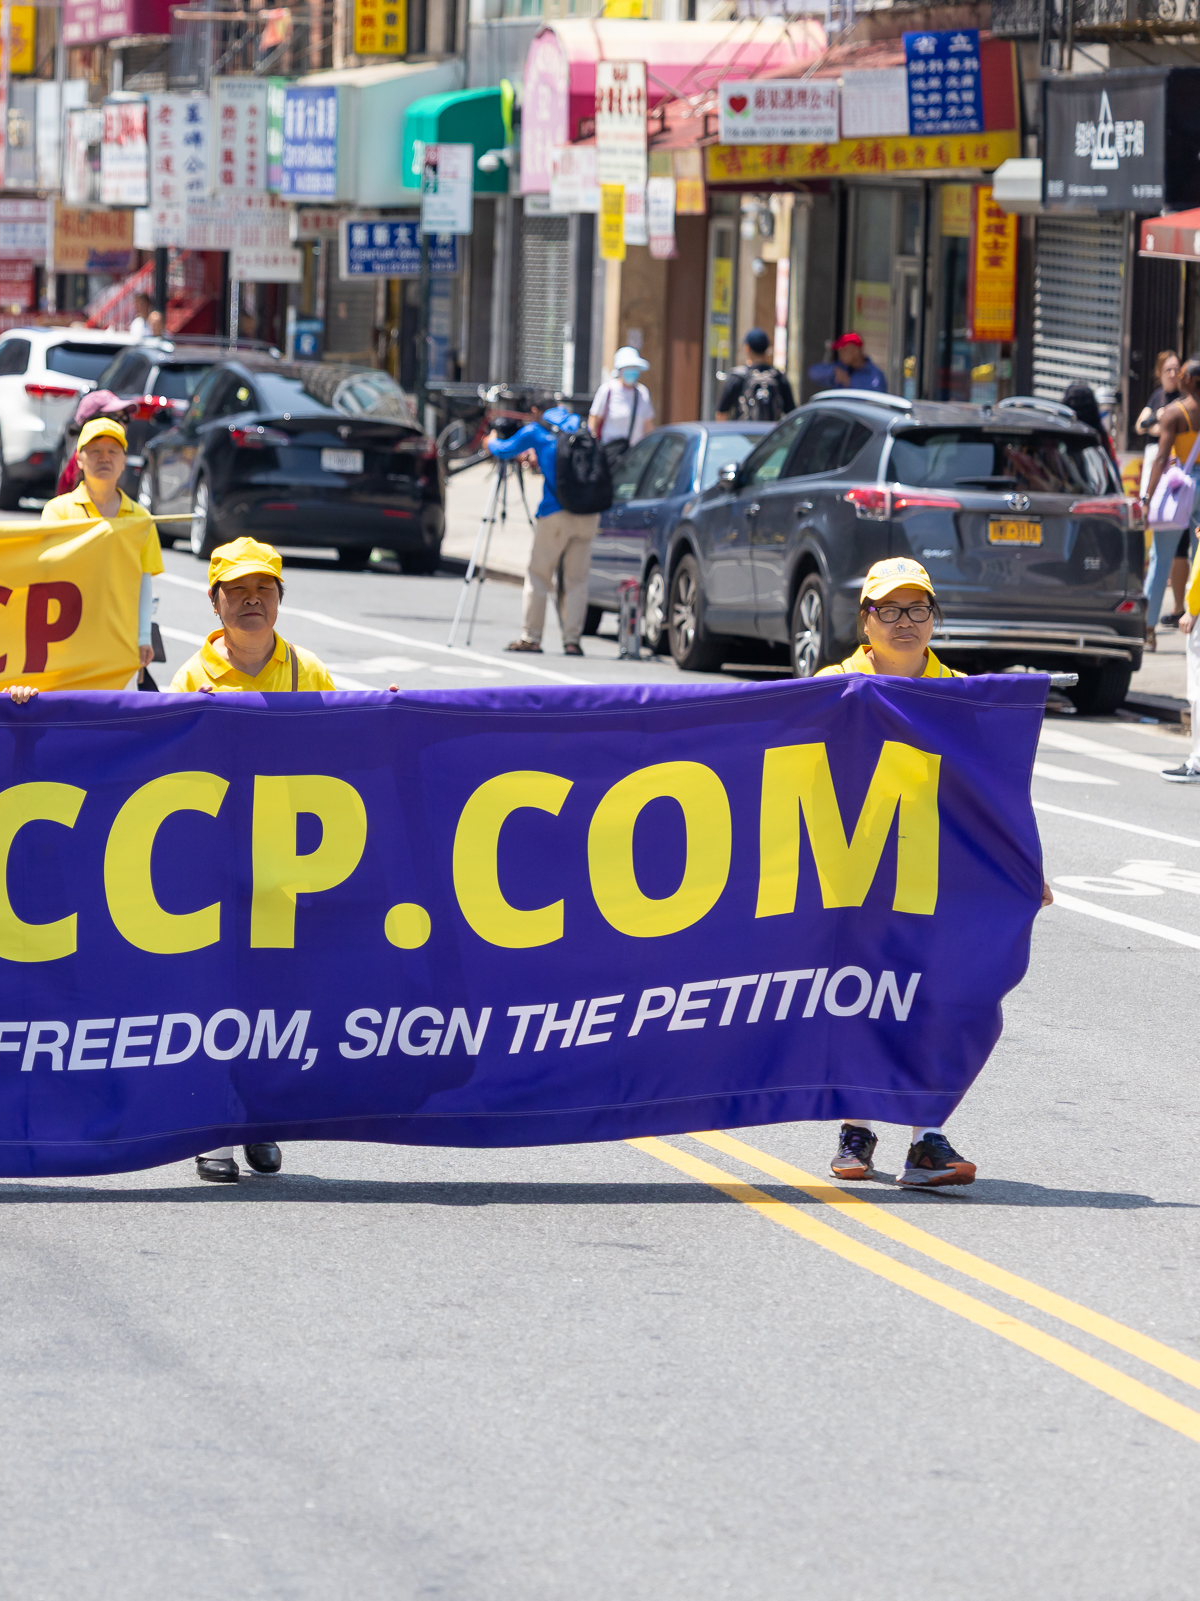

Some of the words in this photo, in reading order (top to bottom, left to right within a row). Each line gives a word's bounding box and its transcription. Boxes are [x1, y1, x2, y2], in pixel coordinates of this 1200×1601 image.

[338, 1006, 493, 1060] SIGN
[506, 993, 626, 1055] THE
[627, 965, 922, 1038] PETITION
